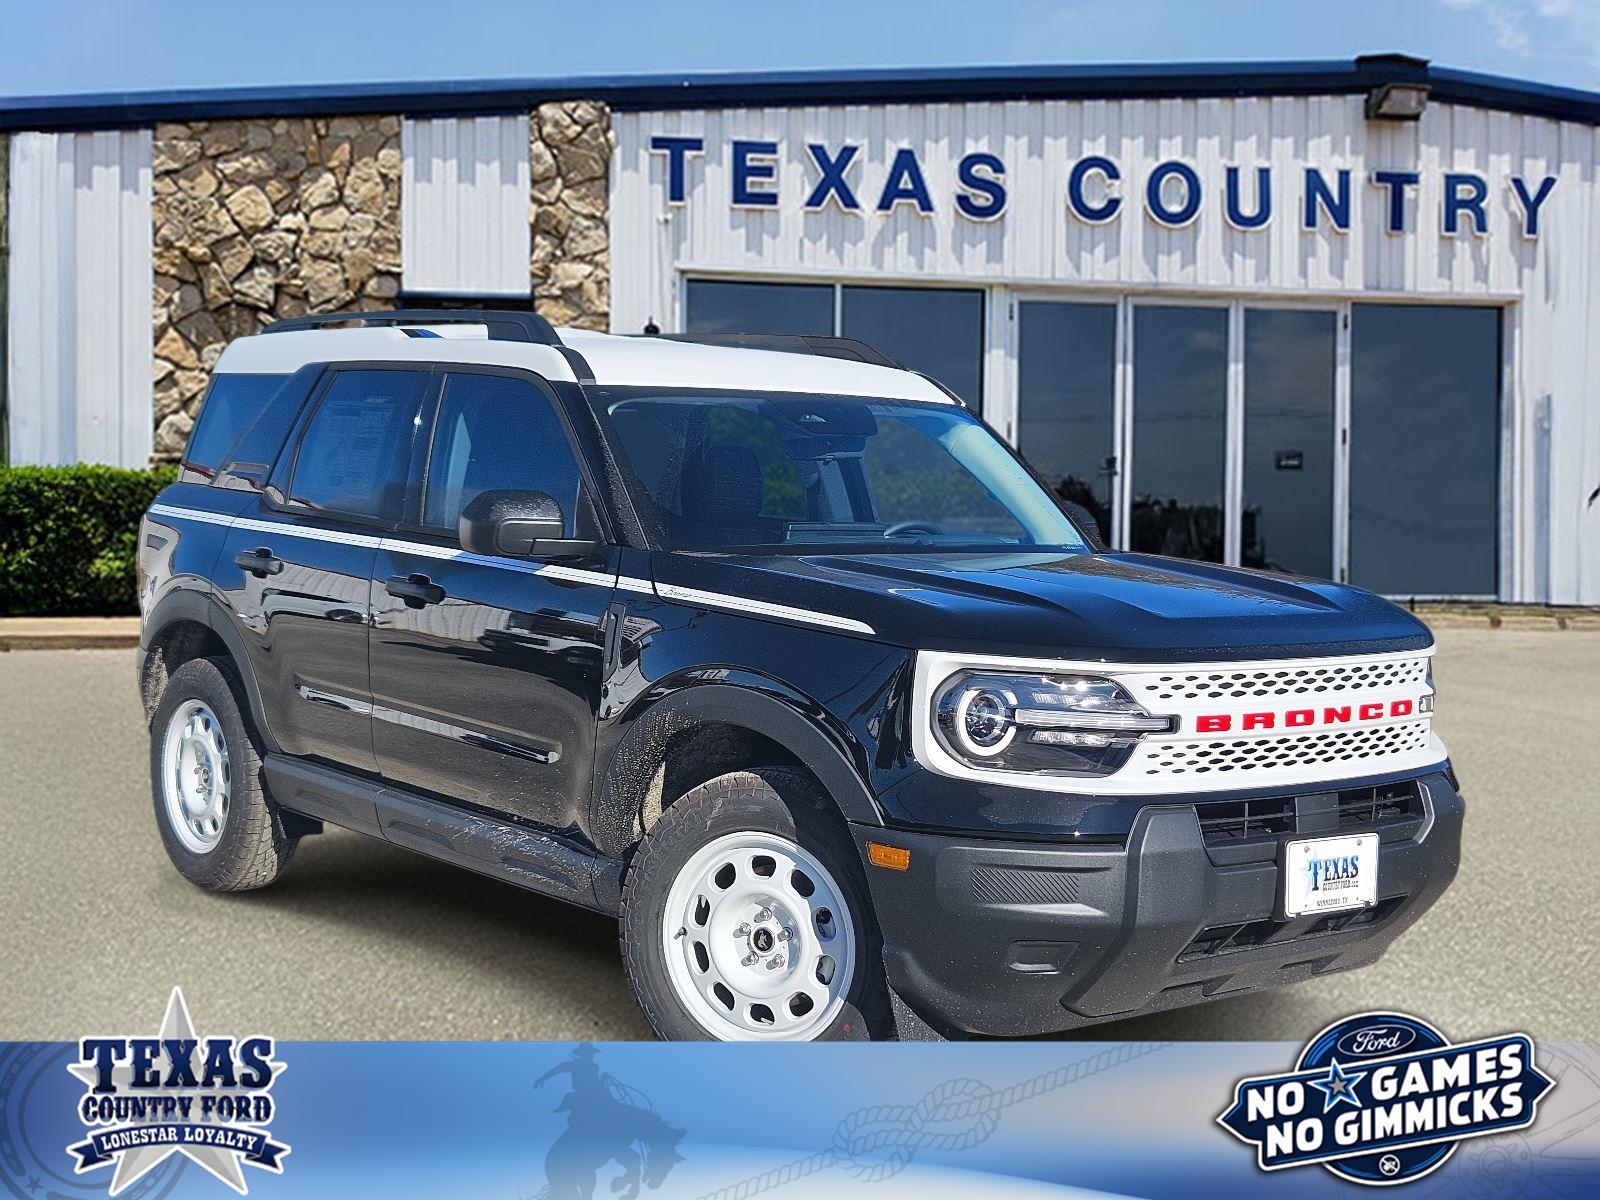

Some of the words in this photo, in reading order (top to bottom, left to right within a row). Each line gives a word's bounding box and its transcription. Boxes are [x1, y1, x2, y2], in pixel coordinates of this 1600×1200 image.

[650, 135, 1007, 220] TEXAS
[1067, 154, 1557, 240] COUNTRY
[1196, 699, 1413, 733] BRONCO
[1307, 855, 1359, 891] TEXAS
